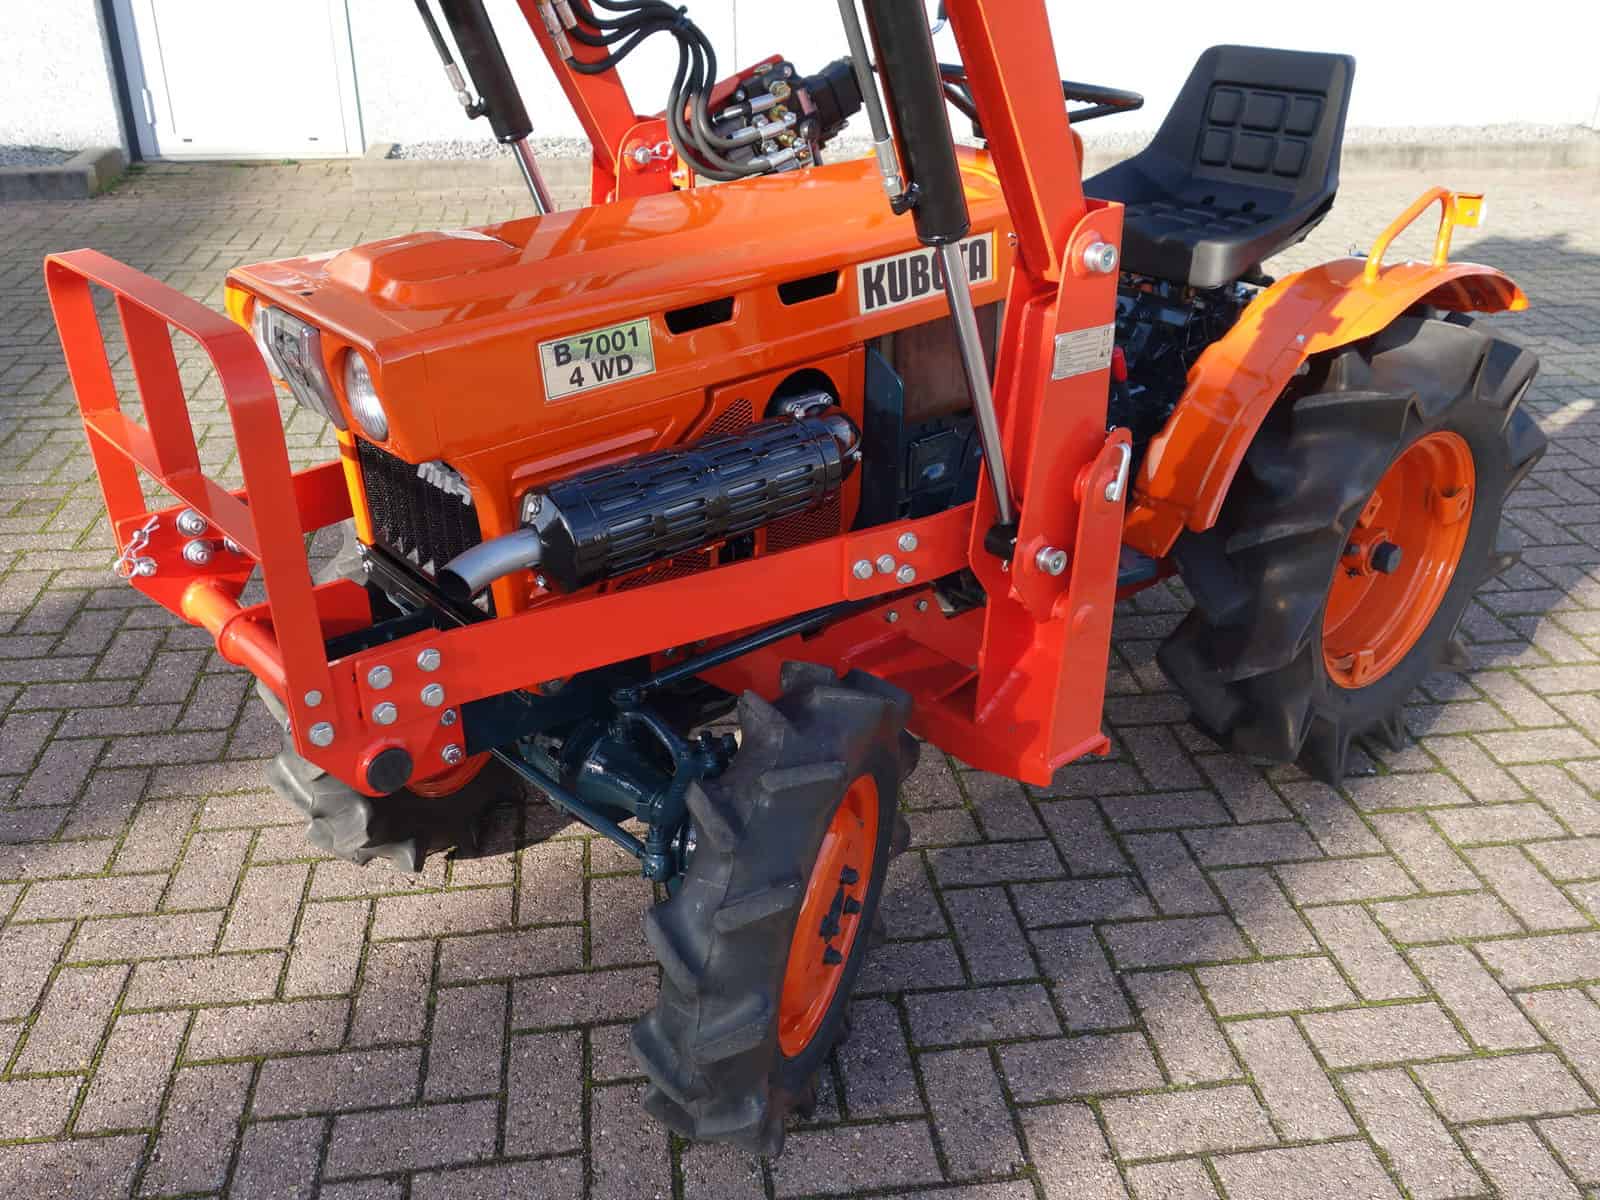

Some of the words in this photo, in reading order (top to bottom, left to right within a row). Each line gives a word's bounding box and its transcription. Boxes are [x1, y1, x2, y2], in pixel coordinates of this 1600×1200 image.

[554, 343, 572, 367] B
[580, 326, 639, 359] 7001
[569, 366, 585, 387] 4
[591, 354, 633, 382] WD
